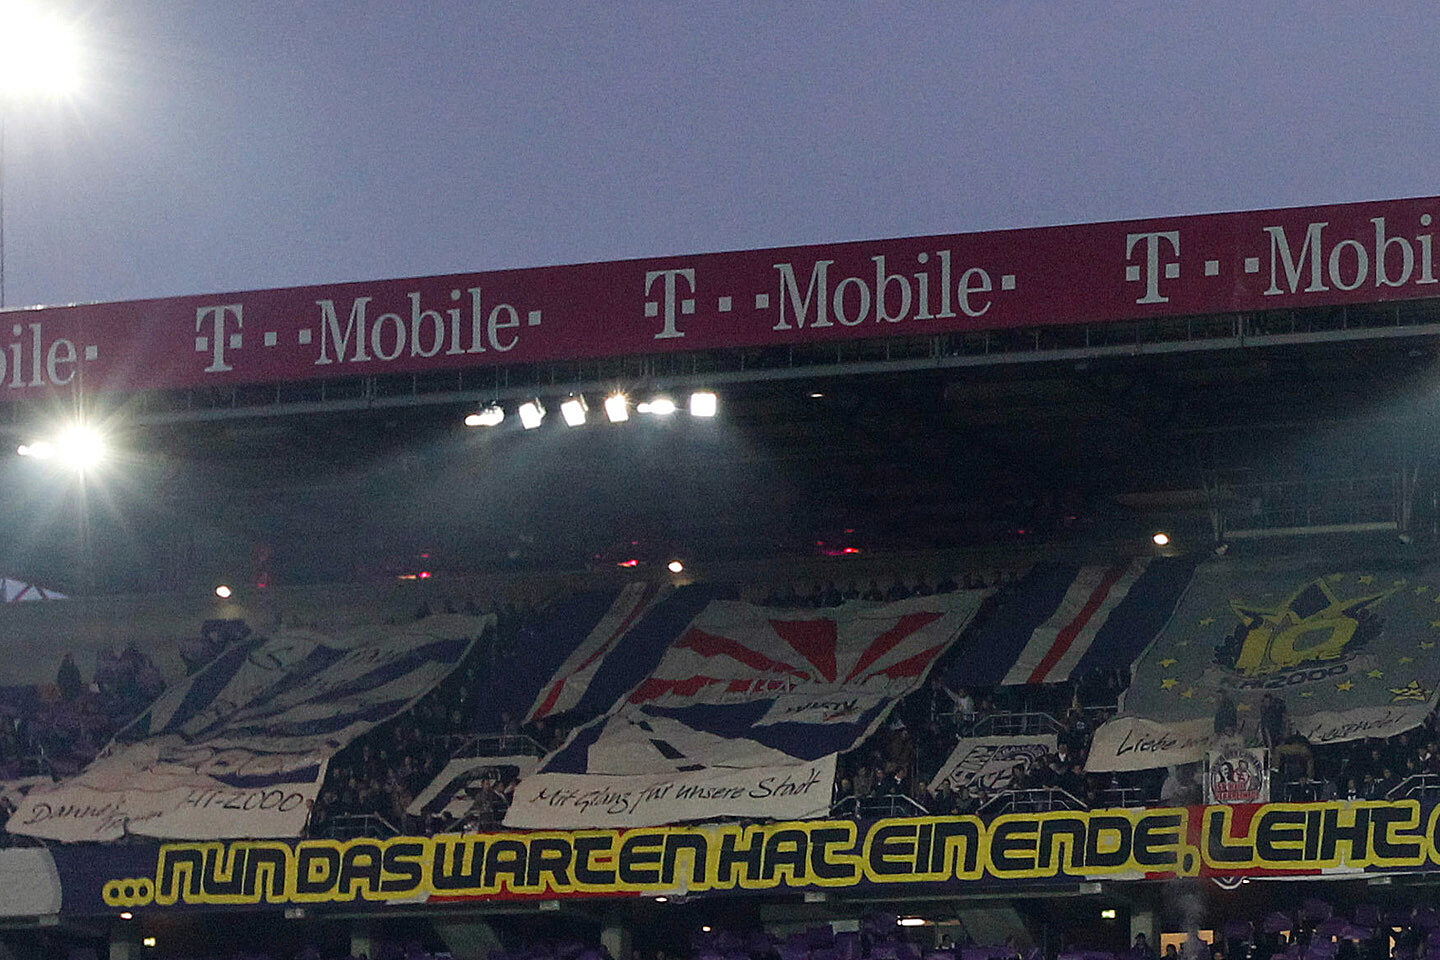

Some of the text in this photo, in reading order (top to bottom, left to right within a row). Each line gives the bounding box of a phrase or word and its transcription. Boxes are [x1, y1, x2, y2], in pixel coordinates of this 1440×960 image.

[313, 286, 521, 367] Mobile
[772, 248, 993, 332] Mobile
[747, 765, 822, 800] Stadt
[299, 841, 433, 899] DAS
[432, 832, 701, 890] WARTEN
[718, 827, 858, 885] HAT
[870, 821, 979, 881] EIN
[1208, 804, 1426, 865] LEIHT
